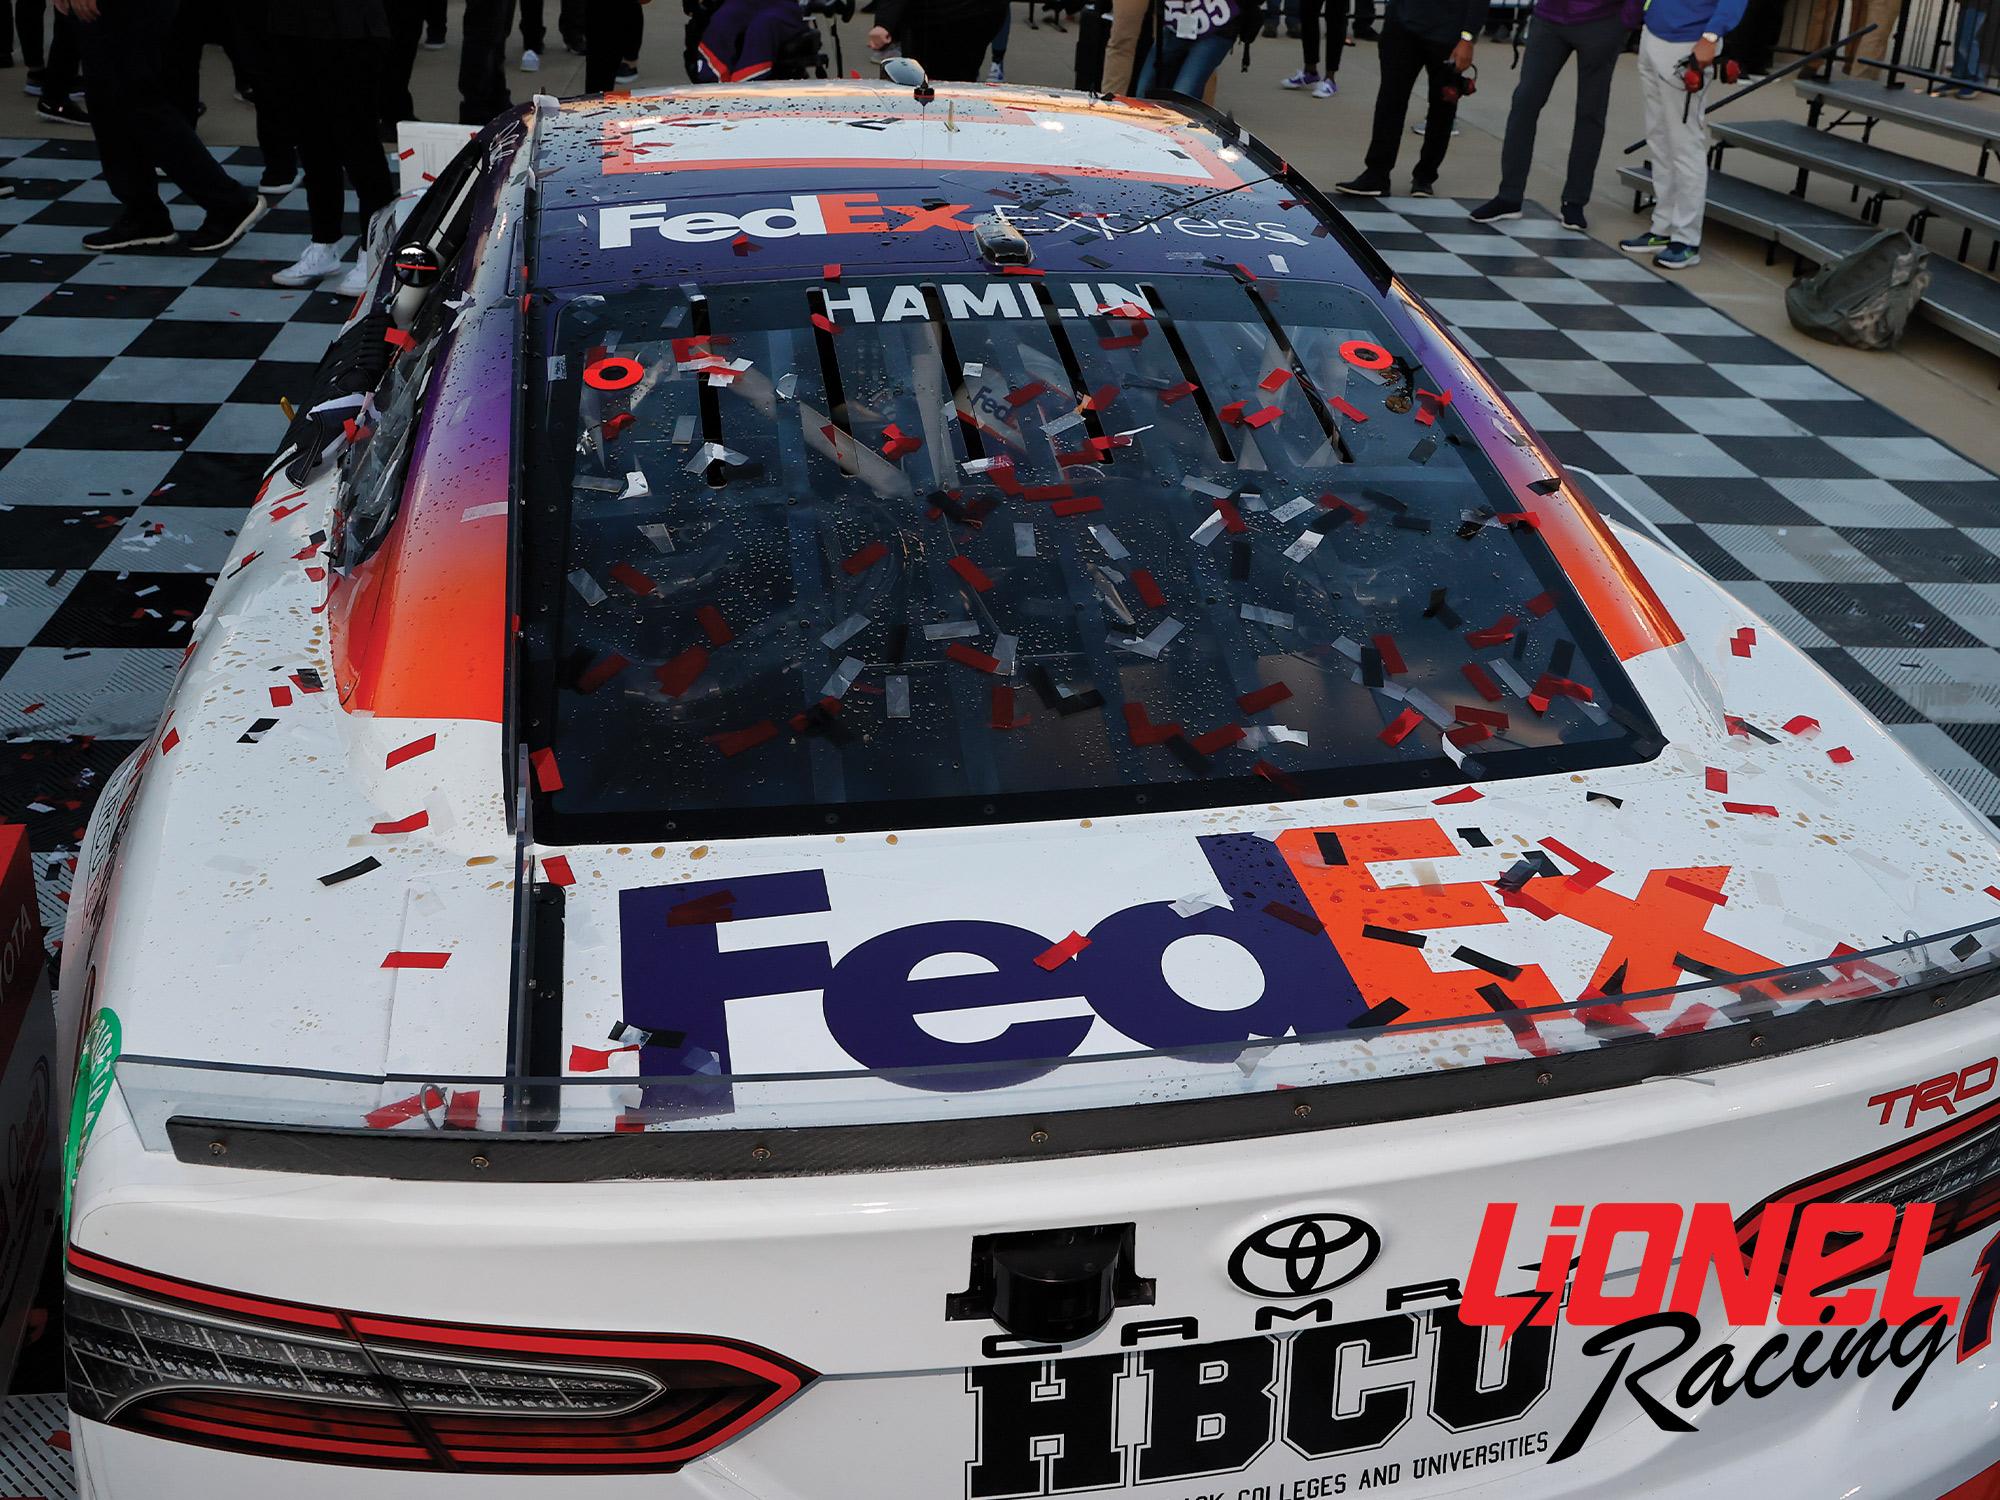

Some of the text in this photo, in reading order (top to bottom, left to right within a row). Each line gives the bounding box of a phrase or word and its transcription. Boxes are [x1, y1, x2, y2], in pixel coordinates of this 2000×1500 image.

[599, 192, 1298, 250] FedEx Express
[822, 282, 1155, 323] HAMLIN
[619, 818, 1800, 1121] FedEx
[1867, 1056, 1999, 1129] TRD
[964, 1283, 1570, 1500] HBCU
[1238, 1431, 1549, 1500] COLLEGES AND UNIVERSITIES
